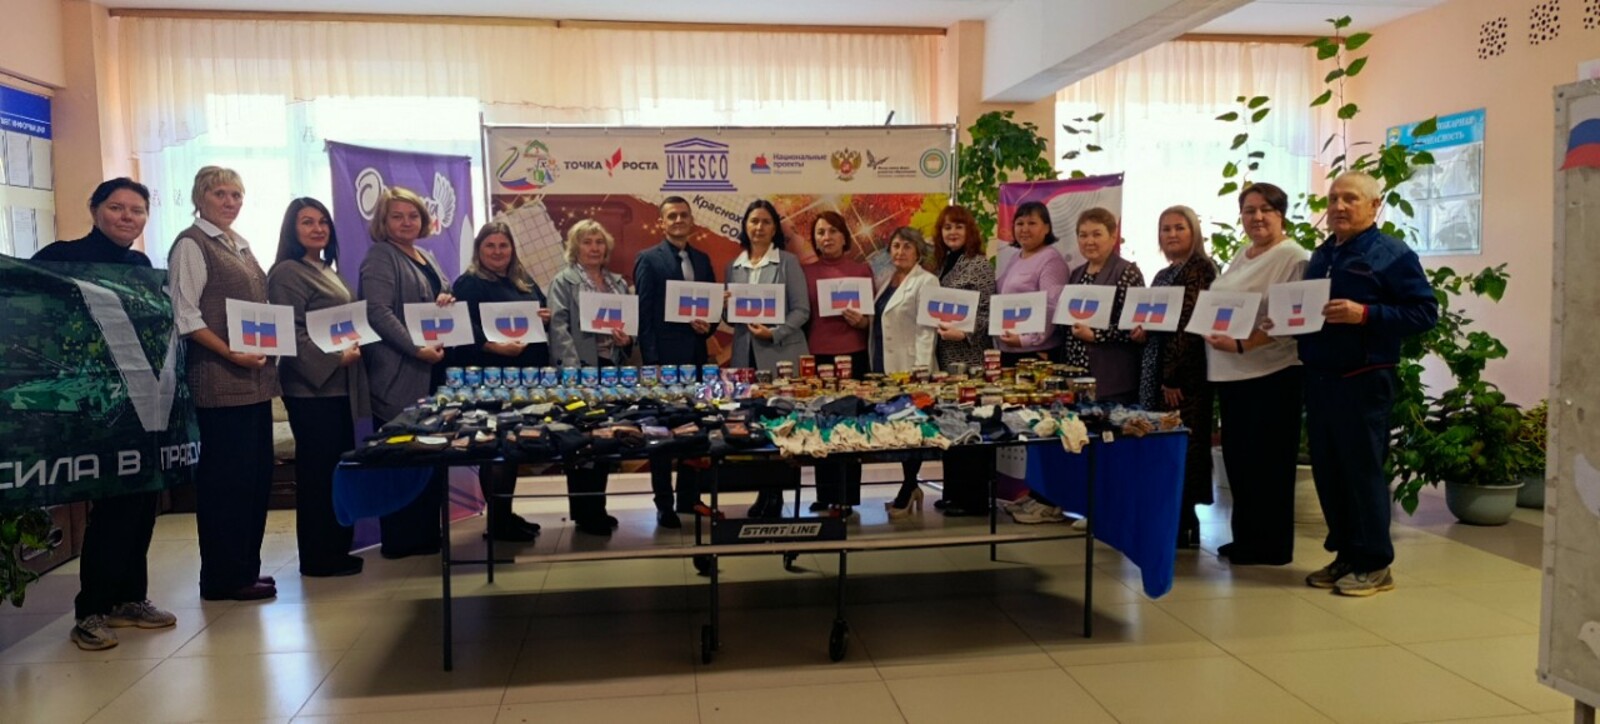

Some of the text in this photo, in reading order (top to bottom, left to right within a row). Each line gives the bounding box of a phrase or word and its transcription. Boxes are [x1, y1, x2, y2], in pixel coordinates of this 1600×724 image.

[563, 161, 659, 170] ТОЧКА РОСТА
[666, 154, 729, 180] UNESCO
[692, 194, 744, 223] Краснох
[720, 223, 742, 240] СО
[241, 279, 861, 348] Н А Р О Д Н Ы Й
[927, 294, 970, 323] Ф
[1001, 300, 1033, 330] Р
[1067, 289, 1100, 320] О
[1131, 292, 1170, 324] Н
[1209, 298, 1245, 333] Т
[0, 453, 100, 489] СИЛА
[118, 450, 141, 476] В
[743, 525, 817, 535] START LINE
